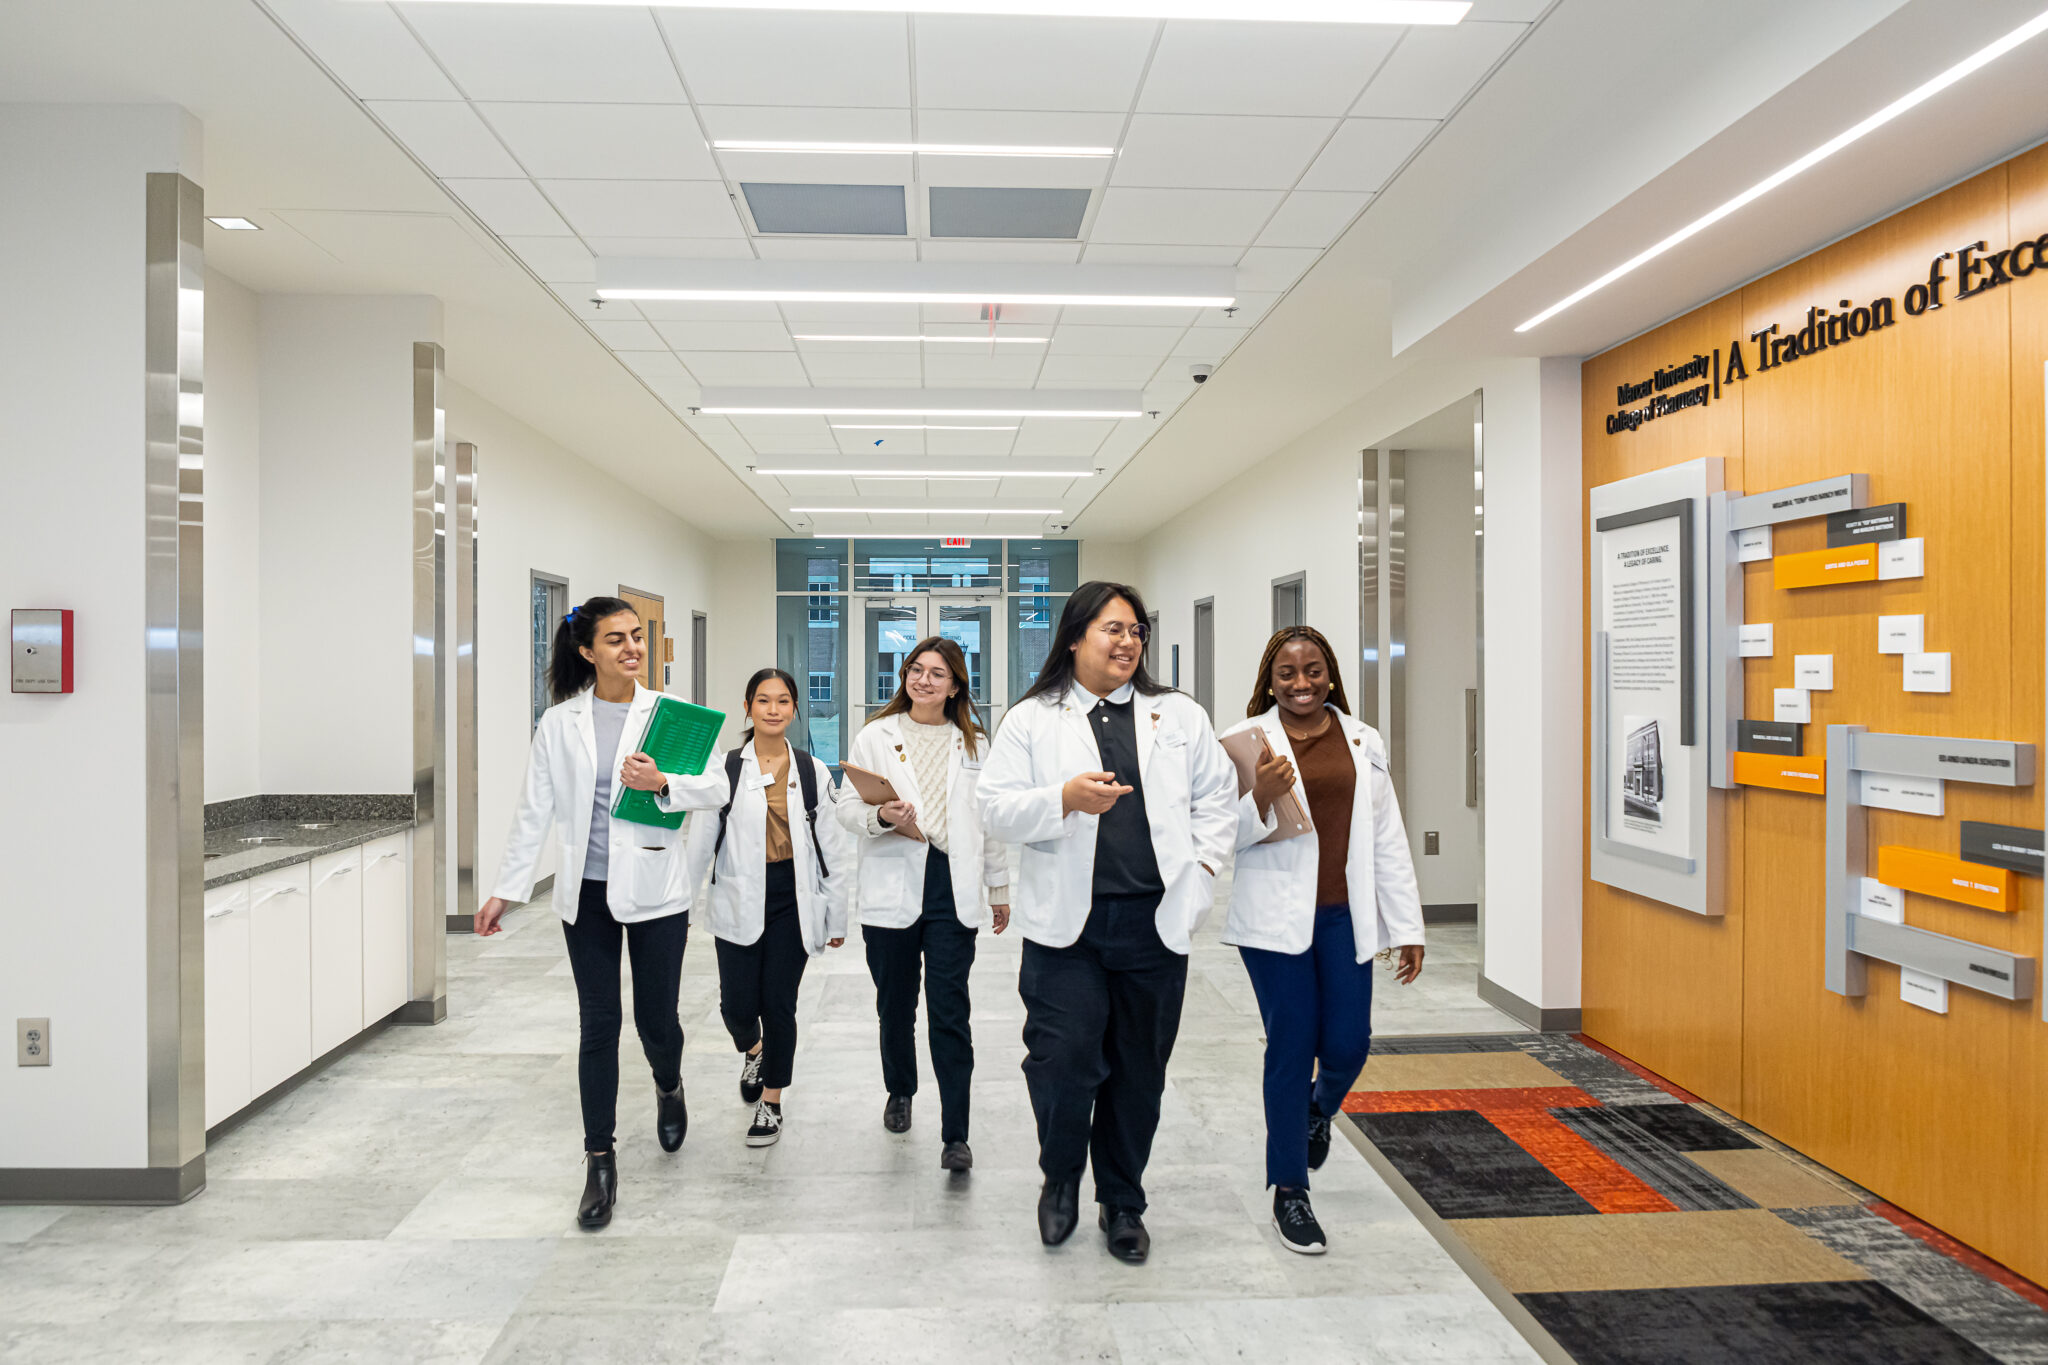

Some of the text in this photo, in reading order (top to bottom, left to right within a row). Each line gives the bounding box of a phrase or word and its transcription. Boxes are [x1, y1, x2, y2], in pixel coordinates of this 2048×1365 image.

[1723, 341, 1749, 385] A
[1751, 297, 1895, 372] Tradition
[1904, 252, 1951, 315] of
[1617, 355, 1710, 406] Mercer University
[1606, 384, 1710, 434] College of Pharmacy
[1620, 550, 1640, 559] TRADITION
[1645, 544, 1669, 556] EXCELLENCE
[1647, 556, 1662, 564] CARING
